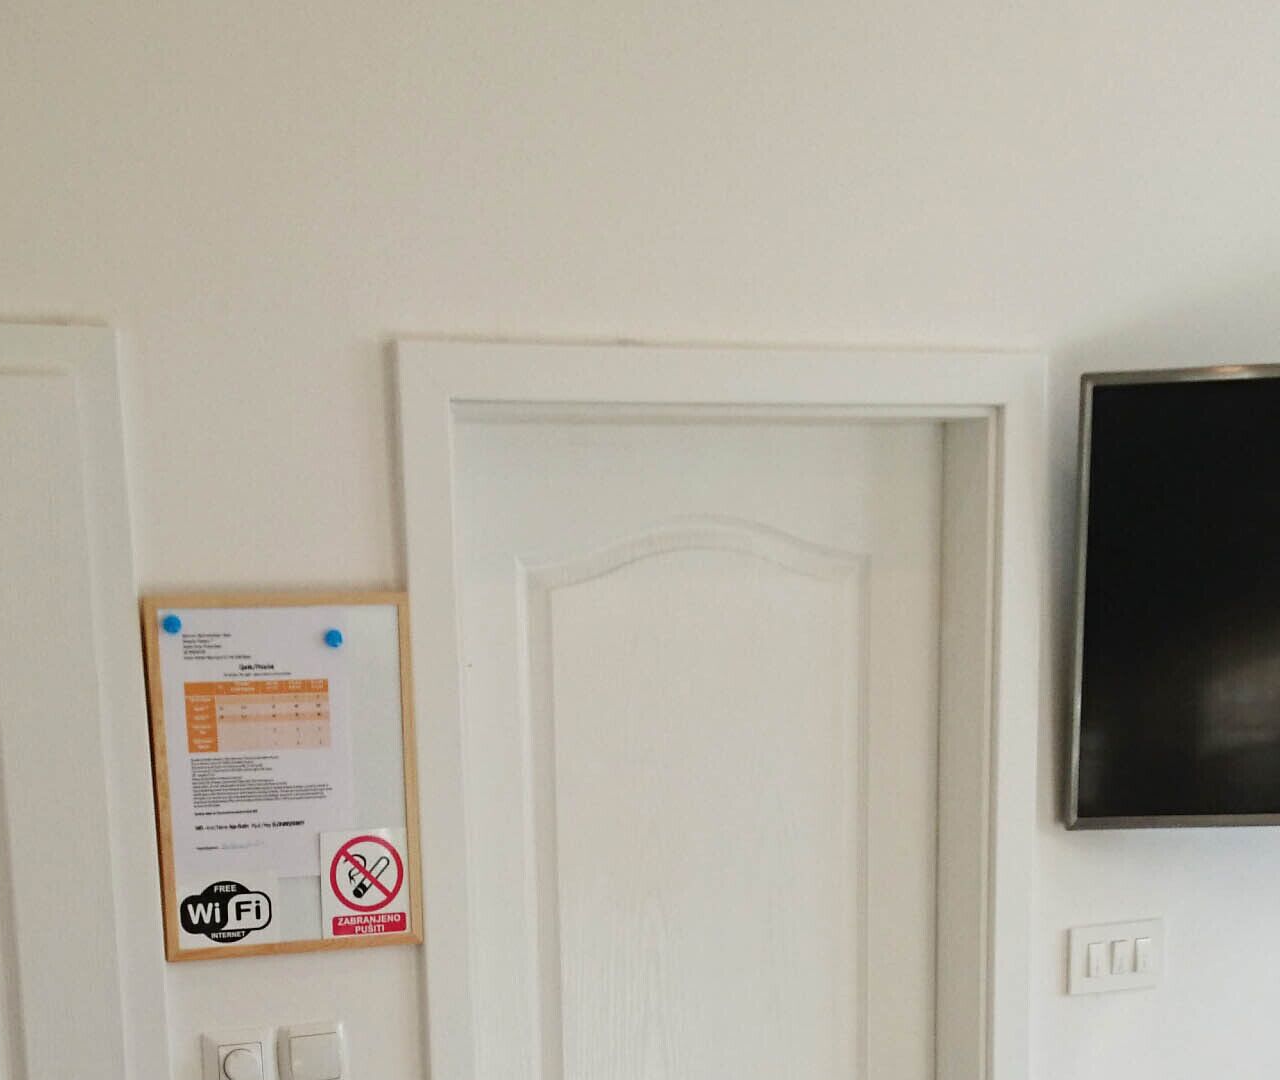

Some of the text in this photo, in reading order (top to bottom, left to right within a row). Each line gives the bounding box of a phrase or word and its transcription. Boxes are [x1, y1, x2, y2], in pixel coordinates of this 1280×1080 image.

[214, 884, 237, 893] FREE
[337, 913, 401, 926] ZABRANJENO
[355, 923, 385, 934] PUŠITI
[210, 930, 246, 939] INTERNET
